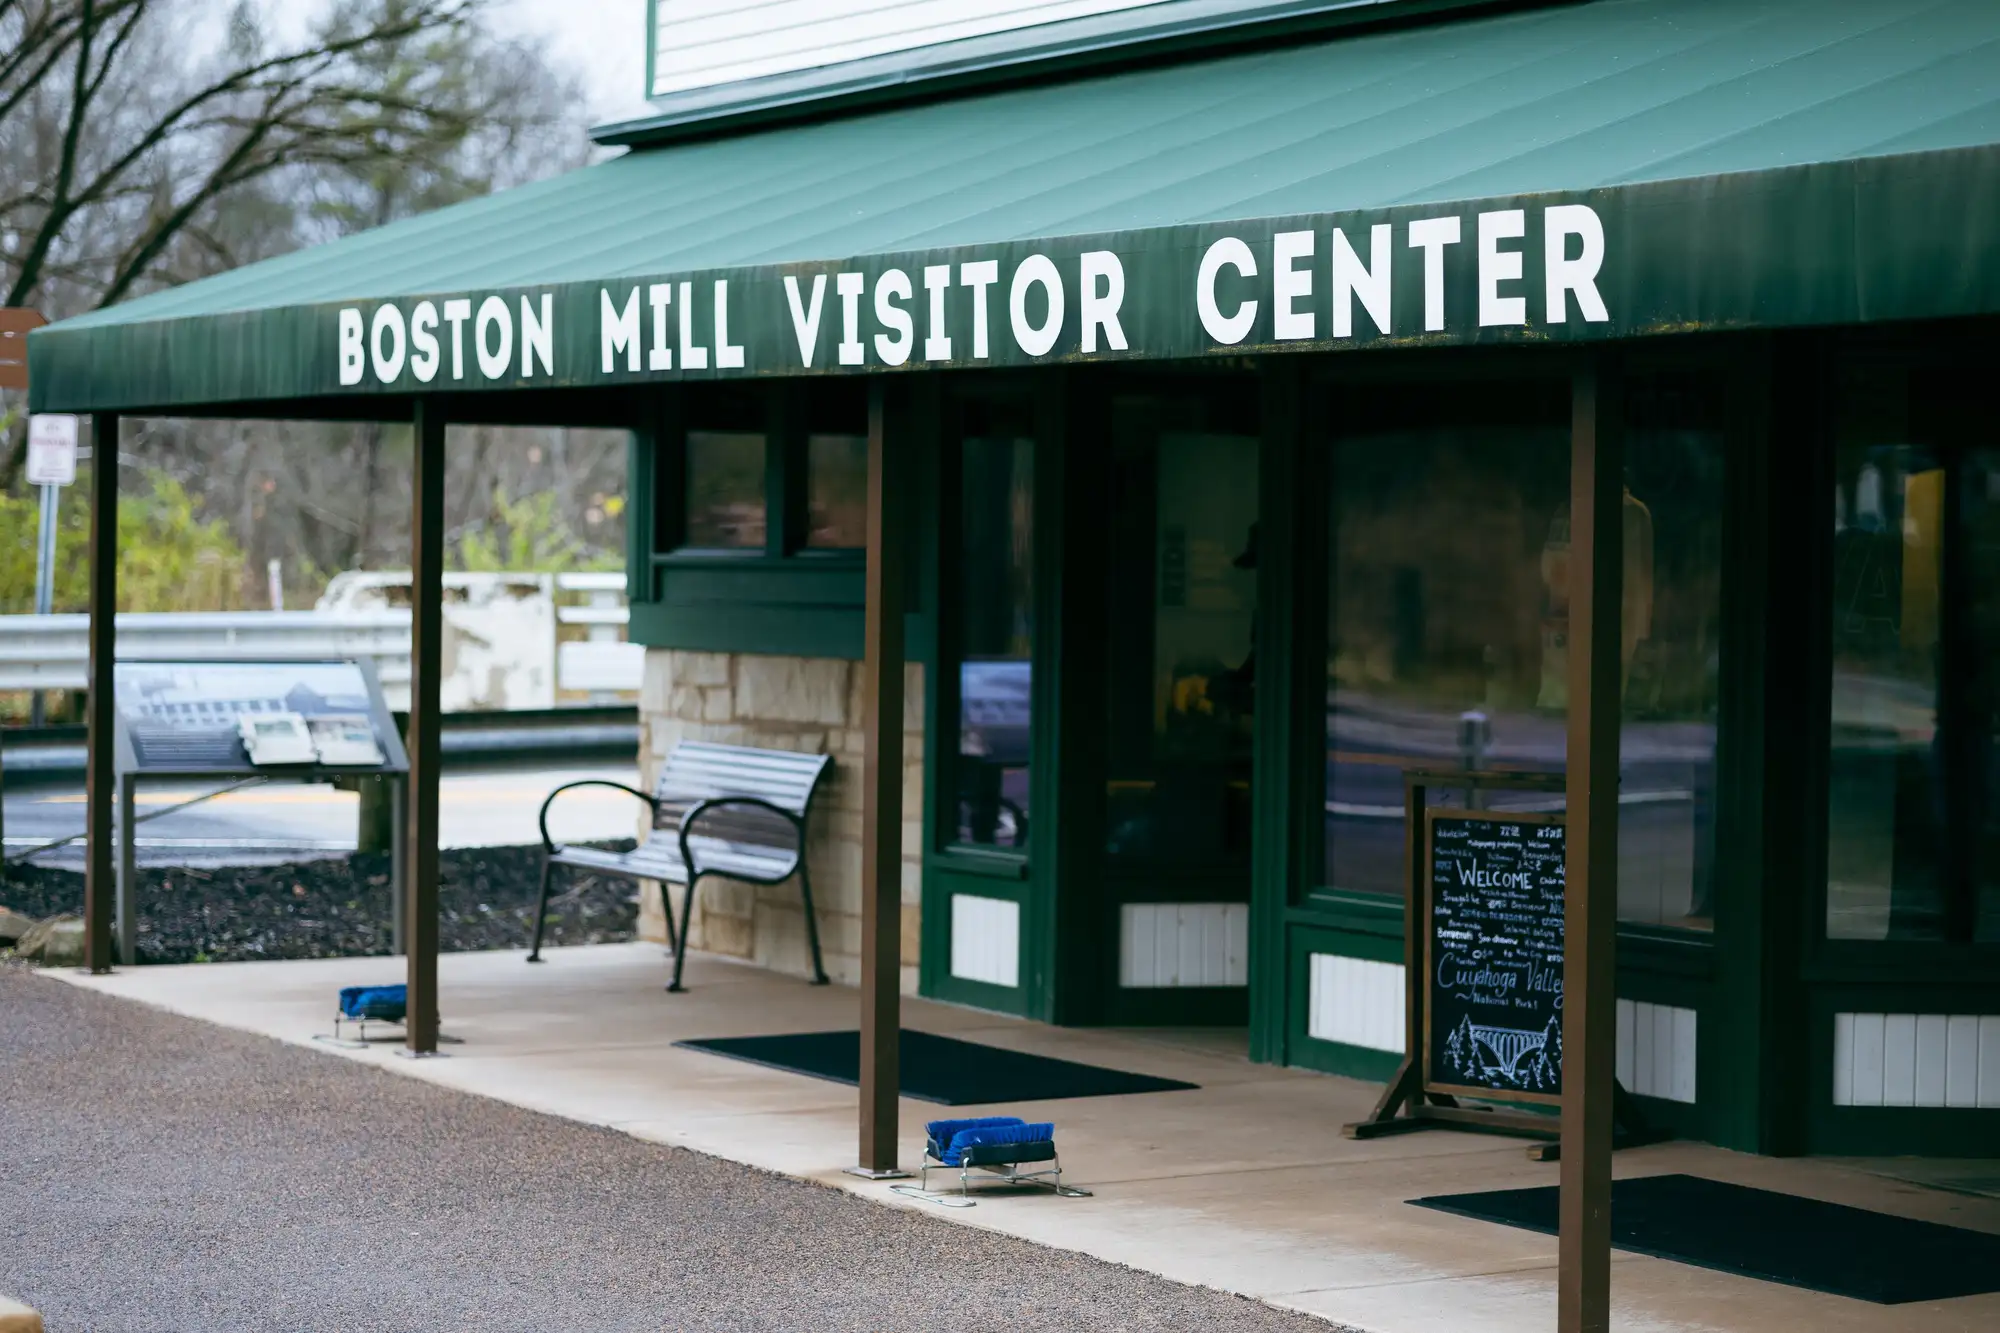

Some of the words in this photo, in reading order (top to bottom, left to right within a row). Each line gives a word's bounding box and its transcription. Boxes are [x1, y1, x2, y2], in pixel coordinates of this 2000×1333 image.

[340, 294, 553, 385] BOSTON
[600, 280, 745, 373] MILL
[783, 250, 1129, 368] VISITOR
[1196, 204, 1609, 345] CENTER
[1456, 858, 1533, 890] WELCOME
[1437, 952, 1517, 997] Cuyahoga
